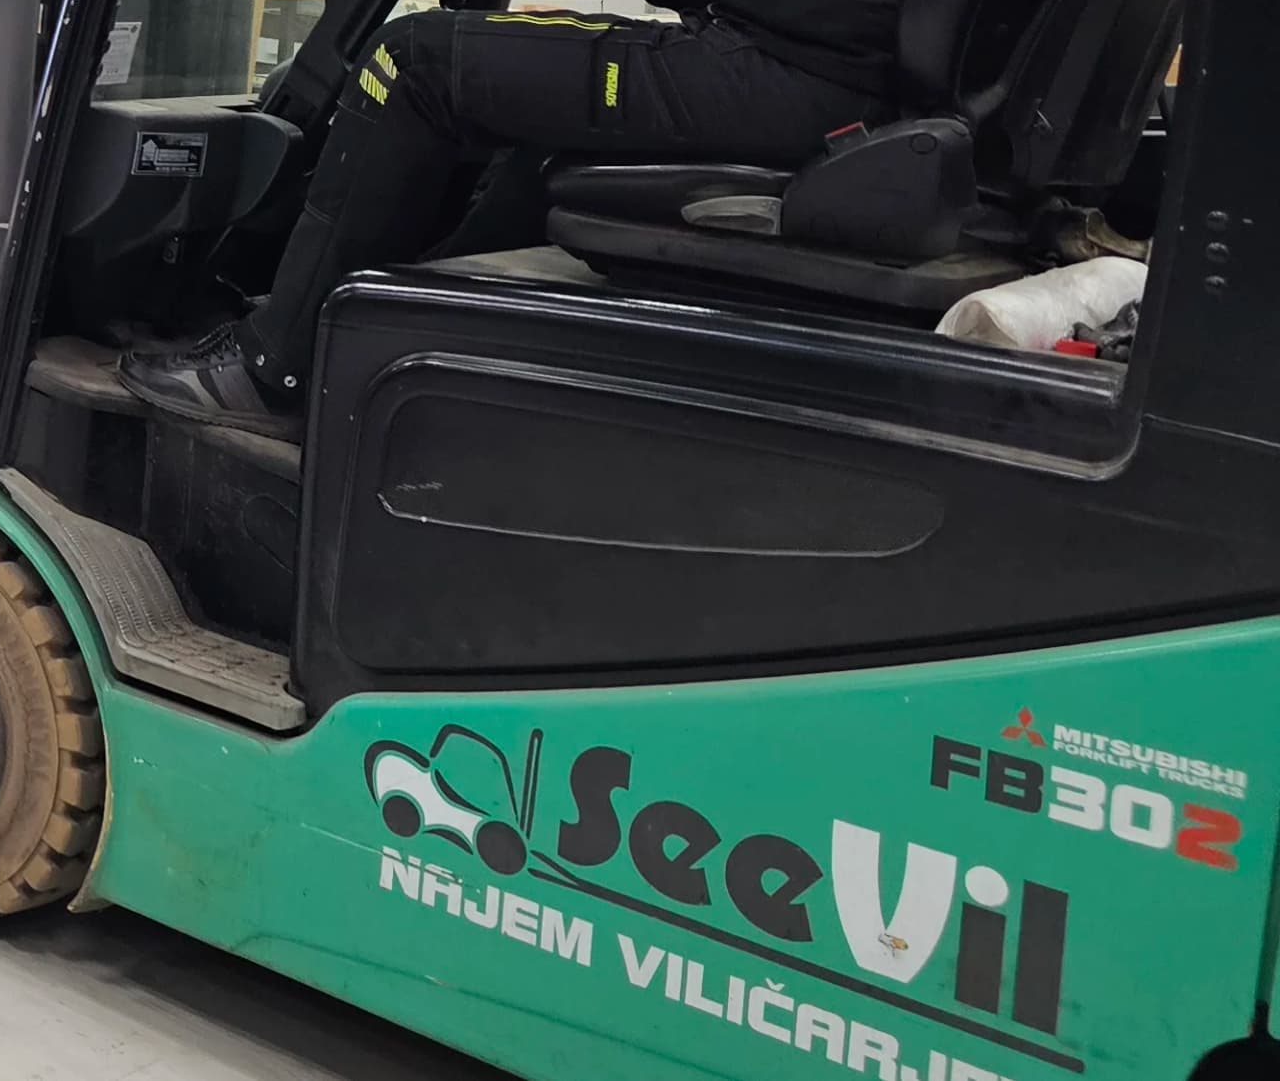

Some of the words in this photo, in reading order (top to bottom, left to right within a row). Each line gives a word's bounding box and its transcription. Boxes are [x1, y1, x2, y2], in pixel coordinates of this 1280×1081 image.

[1052, 739, 1154, 776] FORKLIFT
[1154, 765, 1247, 800] TRUCKS
[1053, 723, 1248, 788] MITSUBISHI
[379, 845, 594, 968] NAJEM
[557, 745, 1069, 1038] SeeVil
